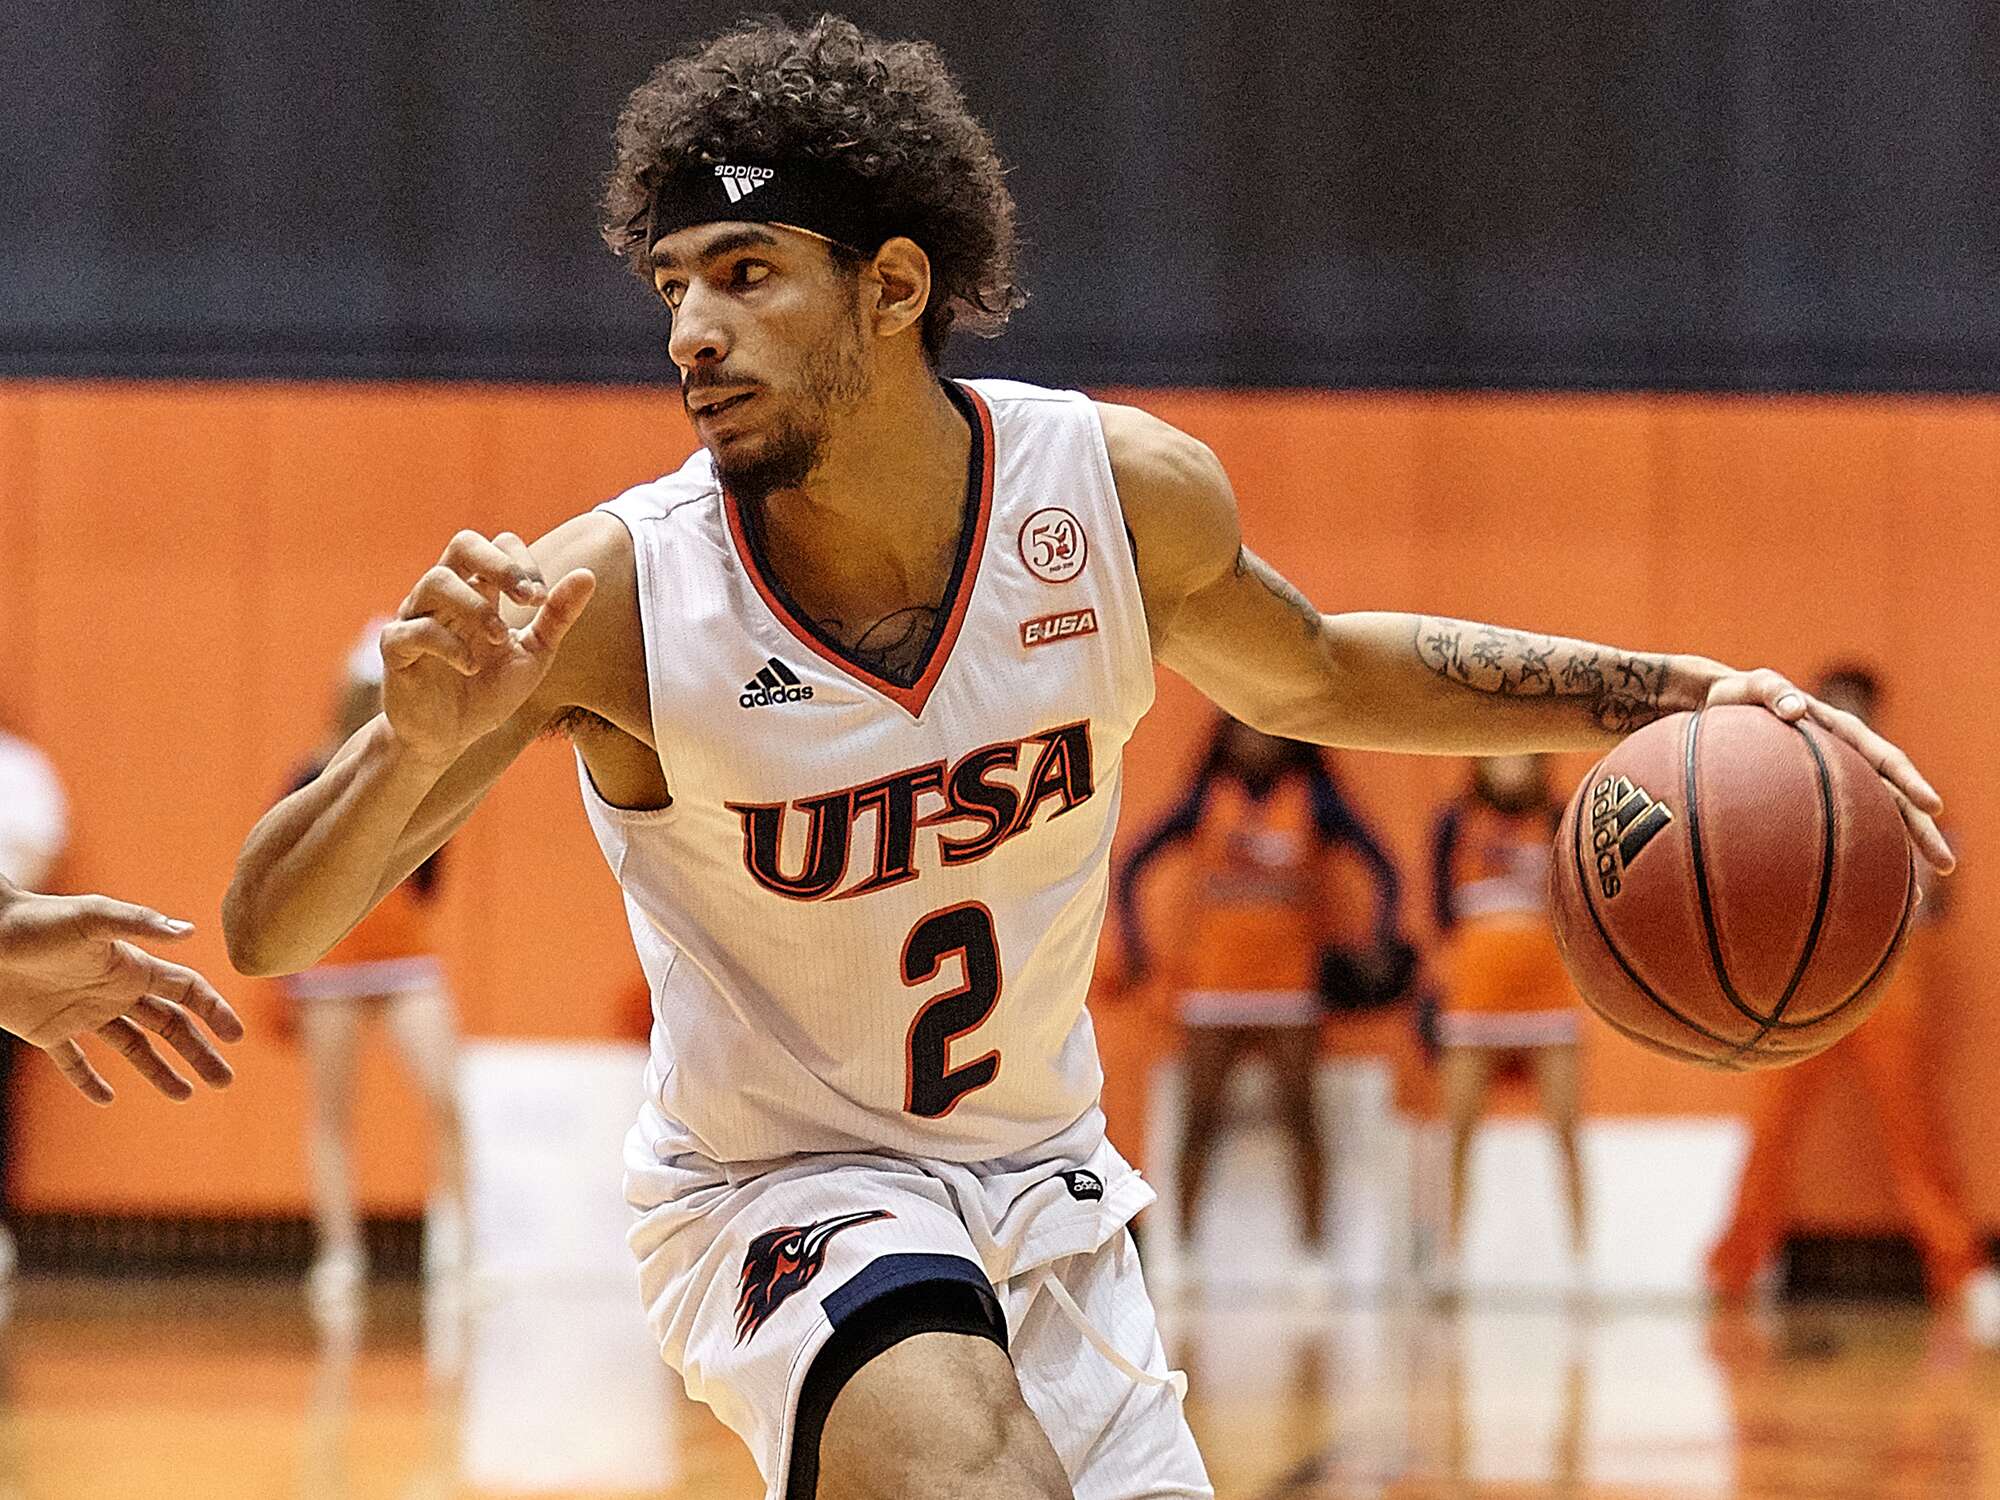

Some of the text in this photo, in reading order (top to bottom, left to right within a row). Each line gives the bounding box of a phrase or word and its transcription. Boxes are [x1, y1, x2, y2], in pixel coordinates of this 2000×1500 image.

[714, 165, 774, 179] adidas
[739, 685, 814, 708] adidas
[724, 719, 1095, 901] UTSA
[1593, 776, 1621, 898] adidas
[900, 900, 1003, 1119] 2
